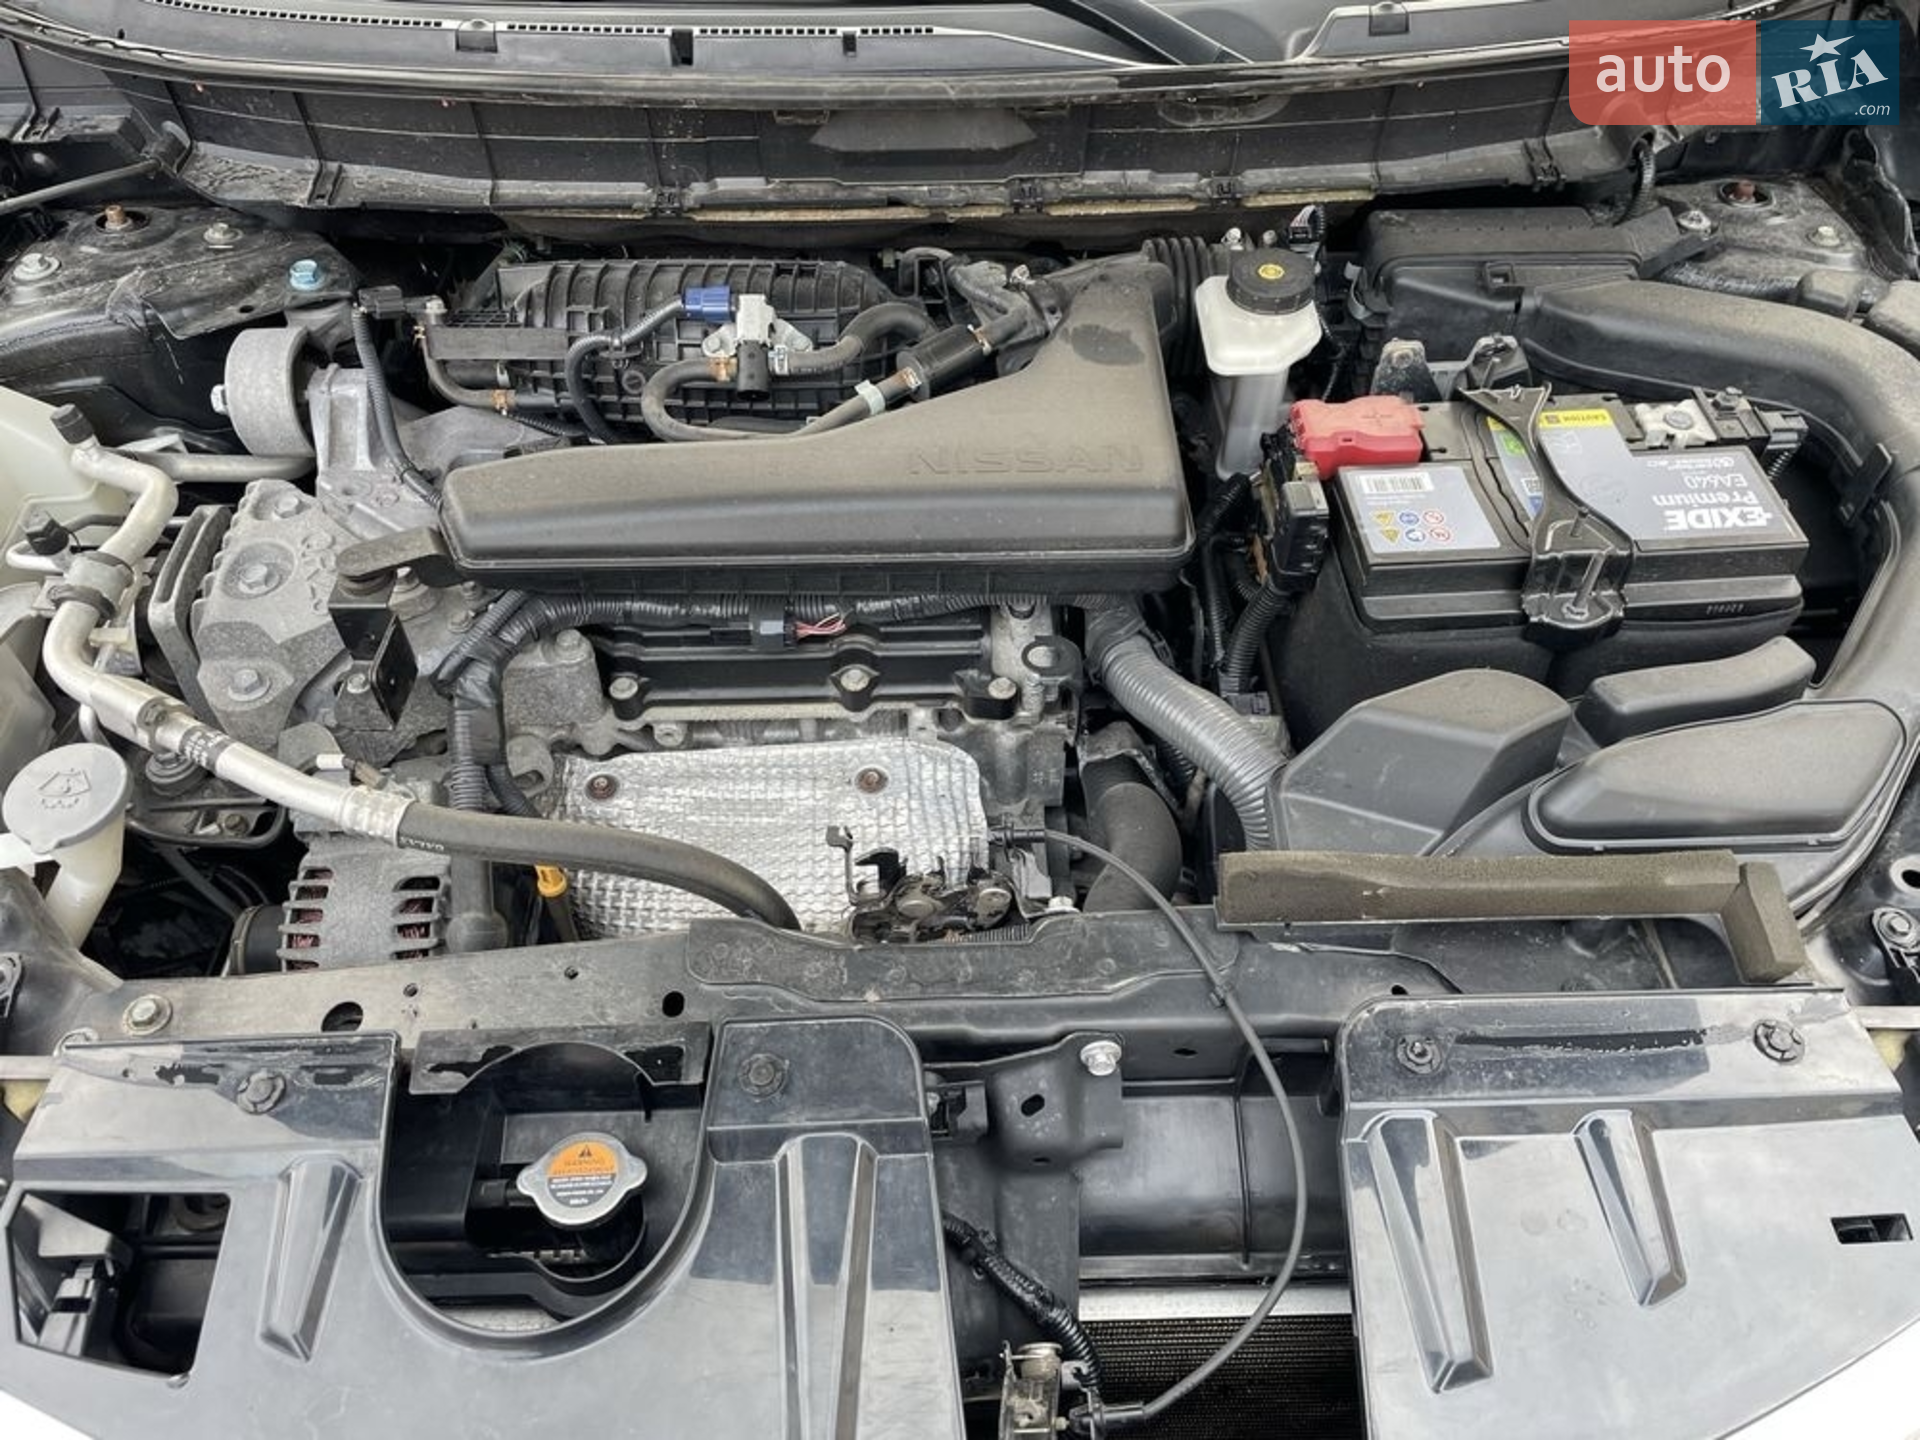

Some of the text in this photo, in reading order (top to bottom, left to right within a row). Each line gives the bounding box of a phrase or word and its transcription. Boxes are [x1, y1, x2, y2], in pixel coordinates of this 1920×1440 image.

[909, 445, 1142, 475] NISSAN
[1683, 473, 1749, 488] EA640
[1651, 490, 1760, 508] Premium
[1664, 506, 1770, 531] EXIDE
